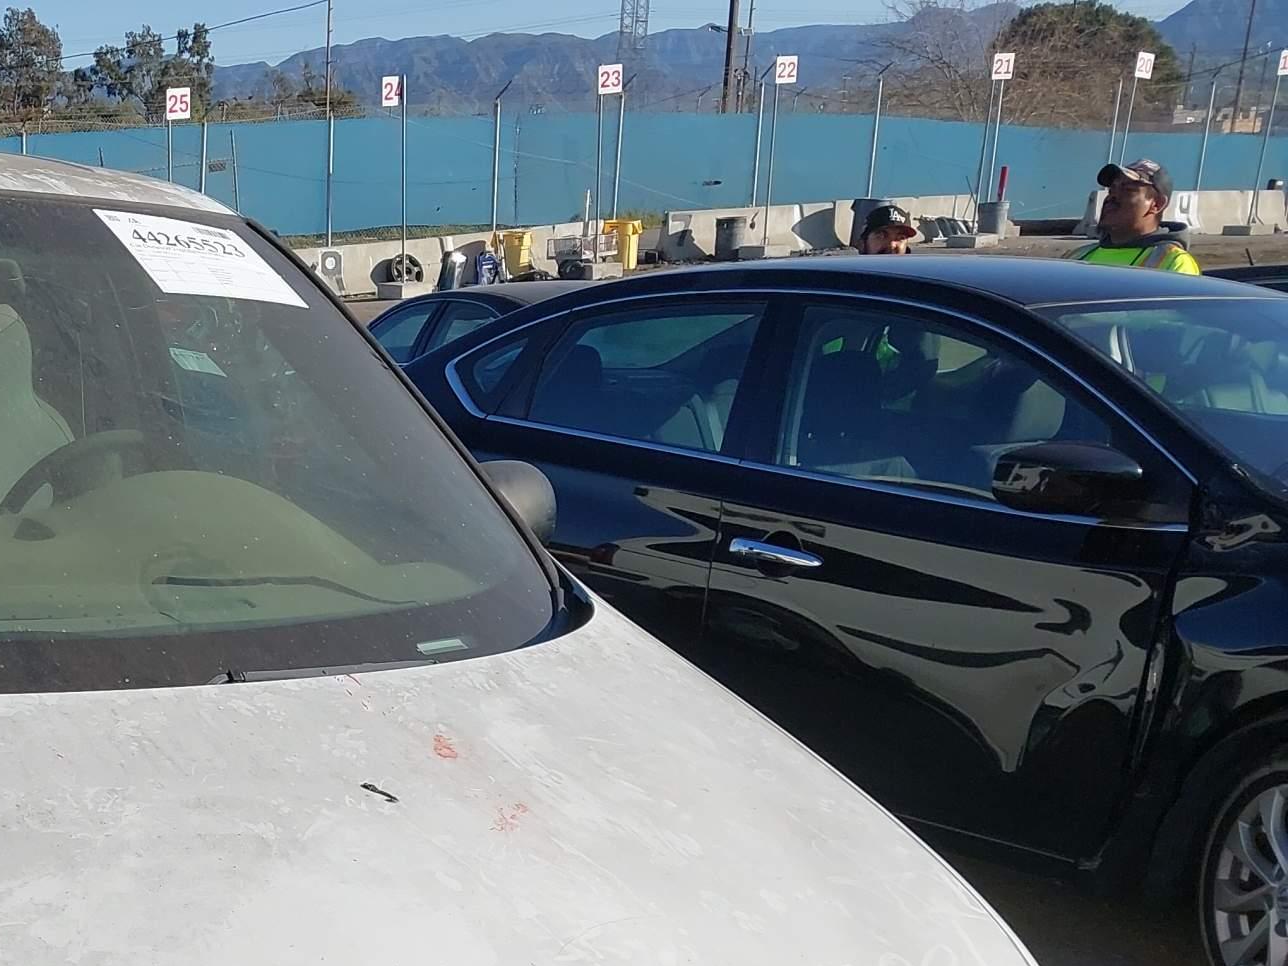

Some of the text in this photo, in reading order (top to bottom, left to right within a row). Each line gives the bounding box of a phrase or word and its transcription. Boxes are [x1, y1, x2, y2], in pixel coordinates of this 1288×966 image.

[777, 61, 796, 79] 22
[993, 58, 1012, 75] 21
[1137, 57, 1152, 74] 20
[600, 70, 621, 88] 23
[383, 82, 402, 101] 24
[168, 94, 189, 113] 25
[888, 207, 906, 223] LA
[132, 229, 247, 258] 44265523
